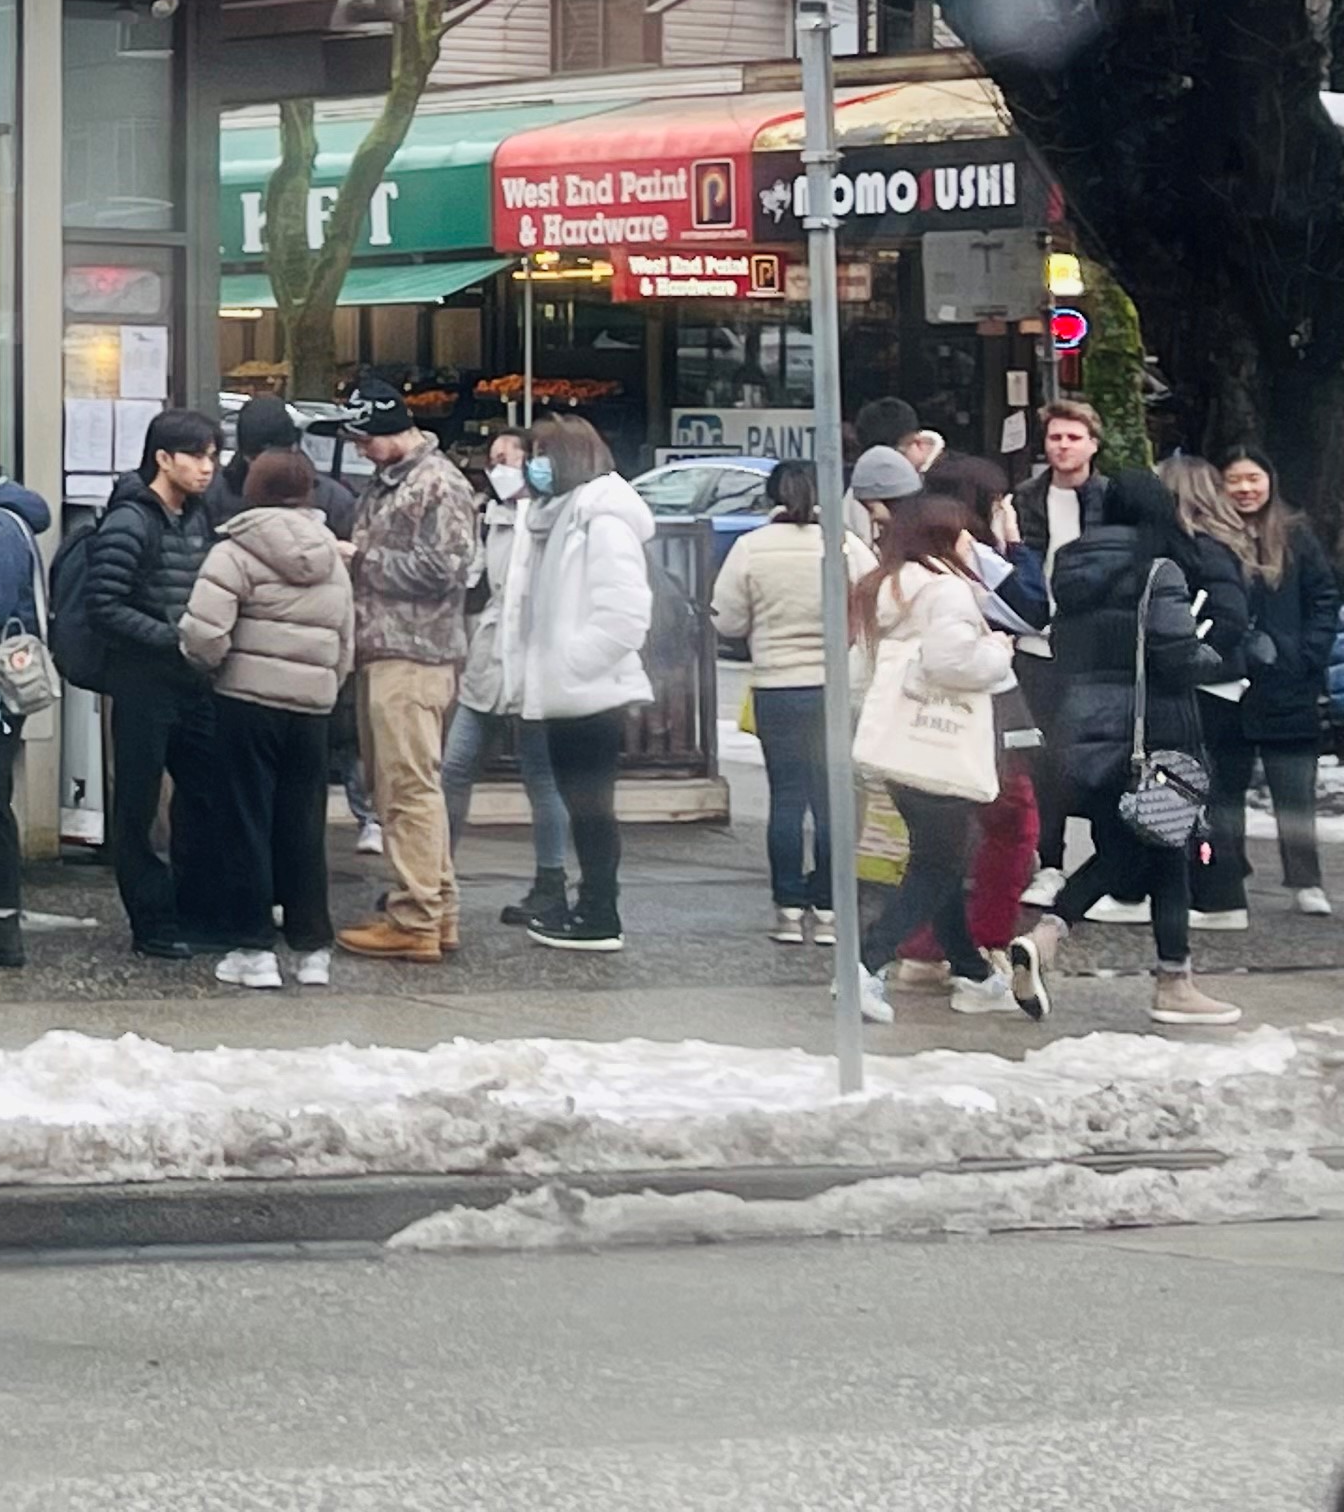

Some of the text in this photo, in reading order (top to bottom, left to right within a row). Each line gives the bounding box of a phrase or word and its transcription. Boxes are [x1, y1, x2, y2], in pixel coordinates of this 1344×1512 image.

[501, 168, 688, 209] West End Paint
[519, 212, 669, 247] & Hardware
